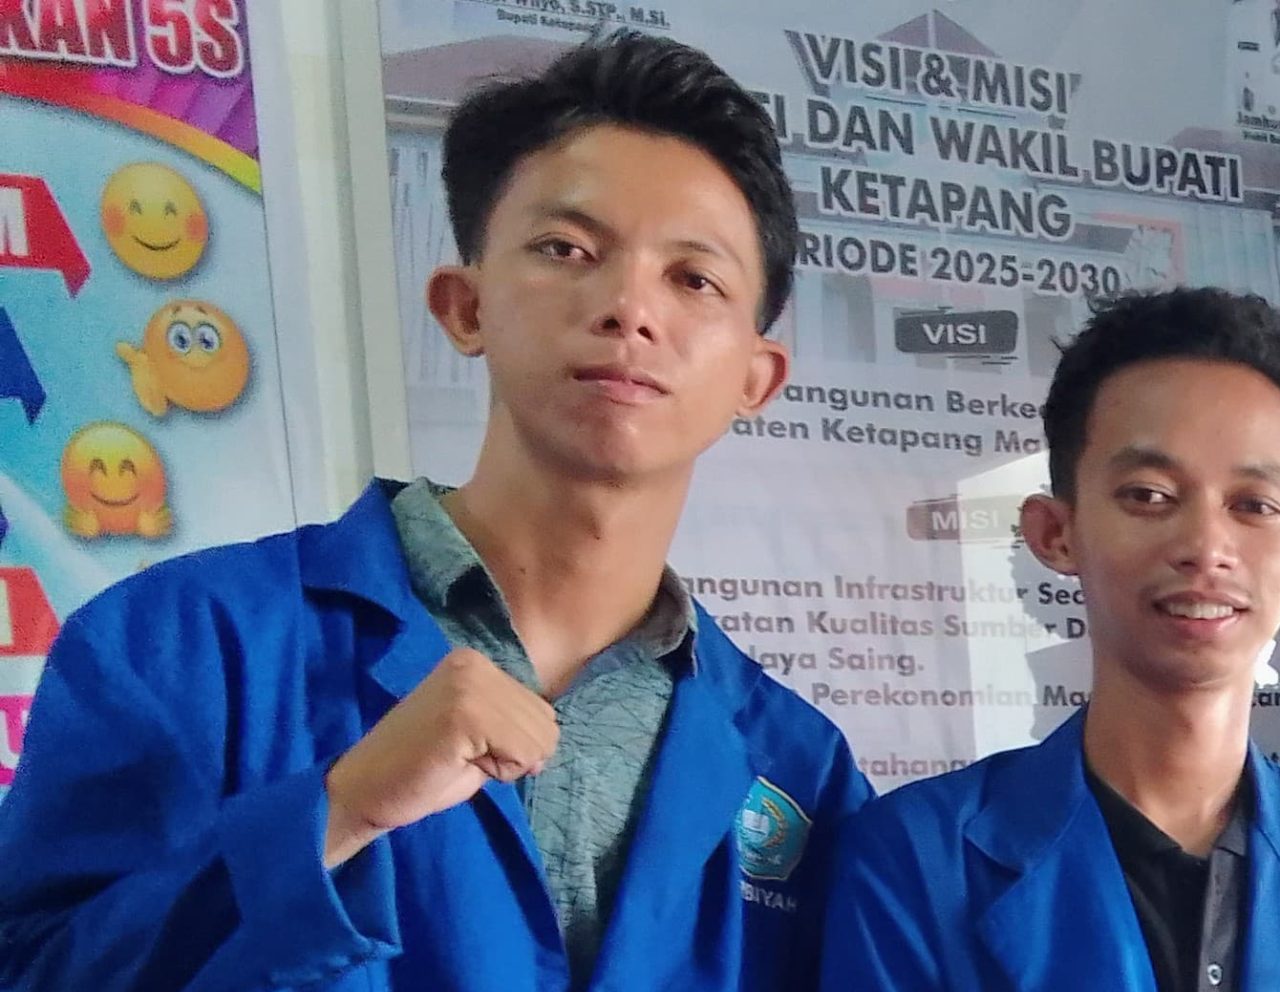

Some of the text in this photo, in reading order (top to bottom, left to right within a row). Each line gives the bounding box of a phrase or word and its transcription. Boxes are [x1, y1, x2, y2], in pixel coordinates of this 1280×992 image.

[146, 0, 243, 77] 5S
[804, 33, 1067, 114] VISI & MISI
[807, 99, 914, 155] DAN
[930, 116, 1079, 177] WAKIL
[1093, 139, 1240, 198] BUPATI
[821, 166, 1071, 237] KETAPANG
[931, 247, 1121, 297] 2025-2030
[923, 323, 987, 345] VISI
[780, 383, 934, 411] angunan
[729, 417, 1049, 456] aten Ketapang Ma
[931, 509, 998, 531] MISI
[834, 575, 1028, 602] Infrastruktur
[714, 612, 795, 633] atan
[806, 611, 934, 637] Kualitas
[944, 614, 1056, 640] Sumber
[828, 647, 925, 677] Saing.
[812, 682, 1033, 708] Perekonomian
[1042, 685, 1092, 708] Ma
